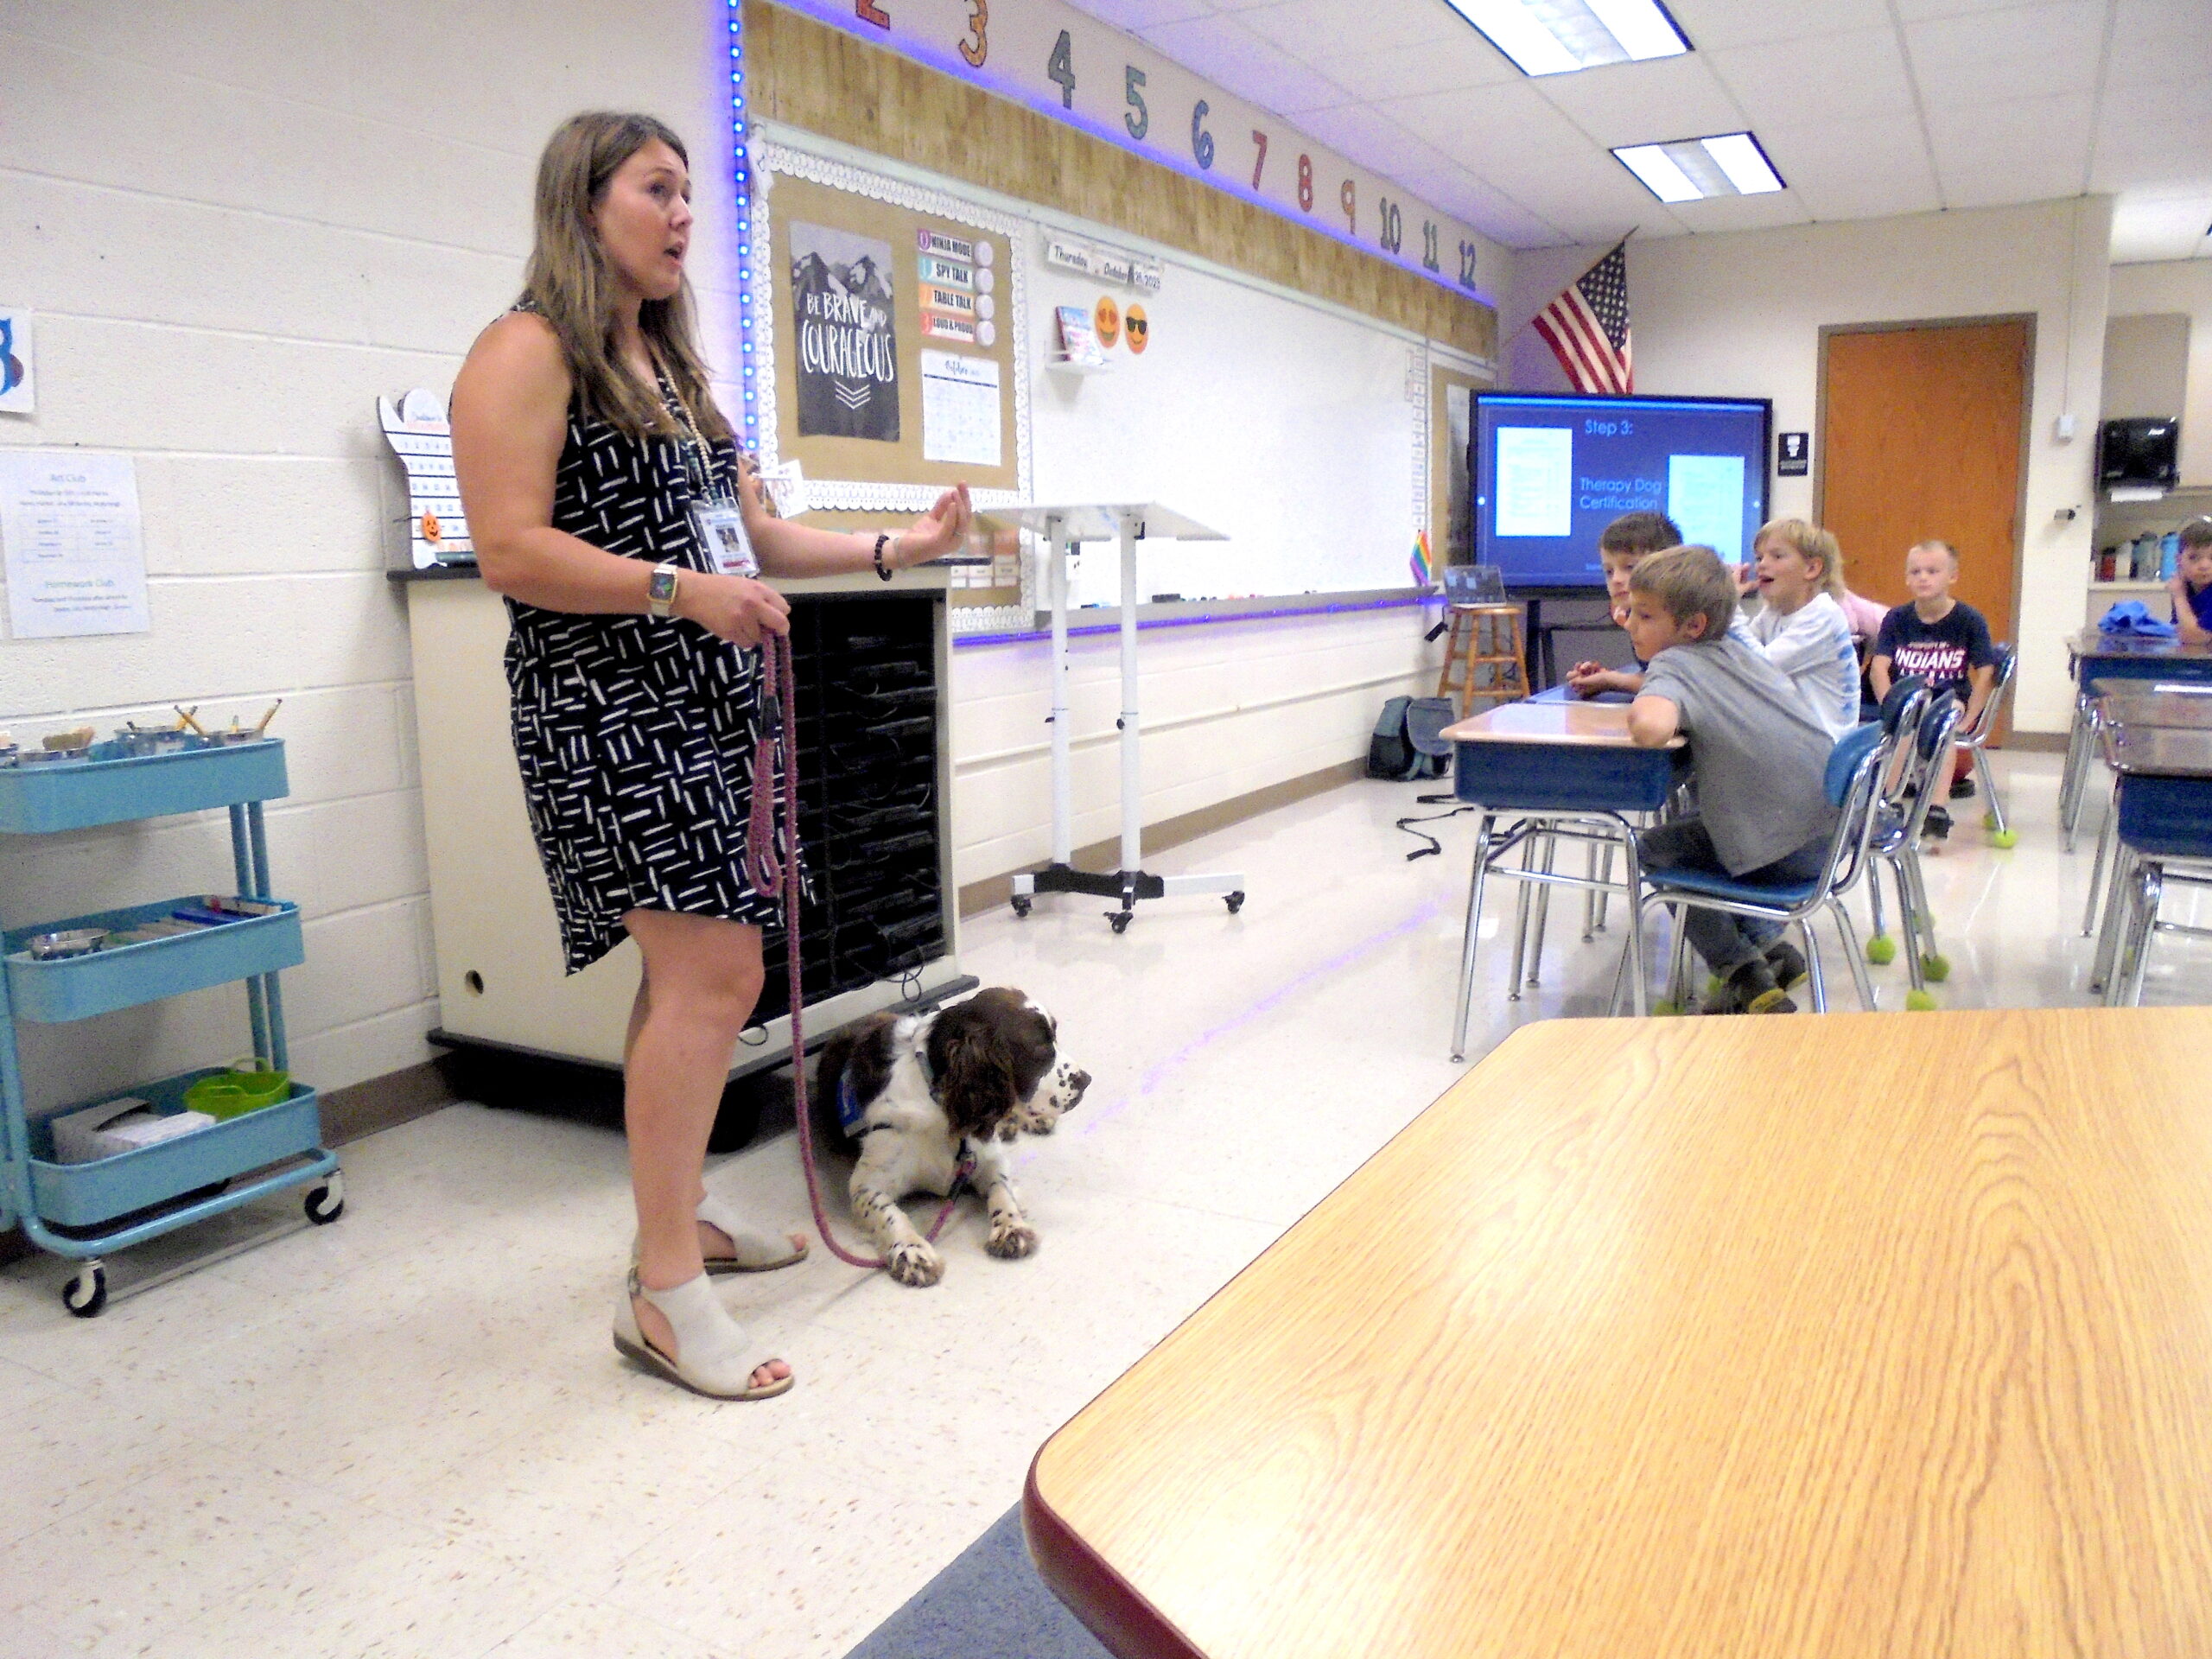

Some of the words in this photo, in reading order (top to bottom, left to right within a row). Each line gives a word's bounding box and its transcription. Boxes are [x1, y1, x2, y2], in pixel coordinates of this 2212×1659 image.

[958, 0, 988, 67] 3
[1048, 29, 1075, 110] 4
[1124, 65, 1148, 140] 5
[1192, 99, 1214, 169] 6
[1252, 129, 1267, 191] 7
[1298, 153, 1313, 213] 8
[1341, 178, 1356, 234] 9
[1380, 196, 1402, 255] 10
[1423, 219, 1440, 273] 11
[1459, 239, 1476, 292] 12
[952, 239, 970, 257] MODE
[936, 263, 950, 277] SPY
[952, 267, 969, 284] TALK
[807, 293, 820, 315] BE
[823, 292, 868, 327] BRAVE
[934, 289, 954, 307] TABLE
[956, 295, 972, 310] TALK
[933, 316, 949, 329] LOUD
[954, 321, 973, 334] PROUD
[802, 319, 893, 382] COURAGEOUS
[1585, 419, 1618, 437] Step
[1621, 421, 1634, 435] 3:
[1580, 477, 1632, 494] Therapy
[1635, 478, 1662, 494] Dog
[1580, 495, 1658, 509] Certification
[1895, 646, 1966, 669] INDIANS
